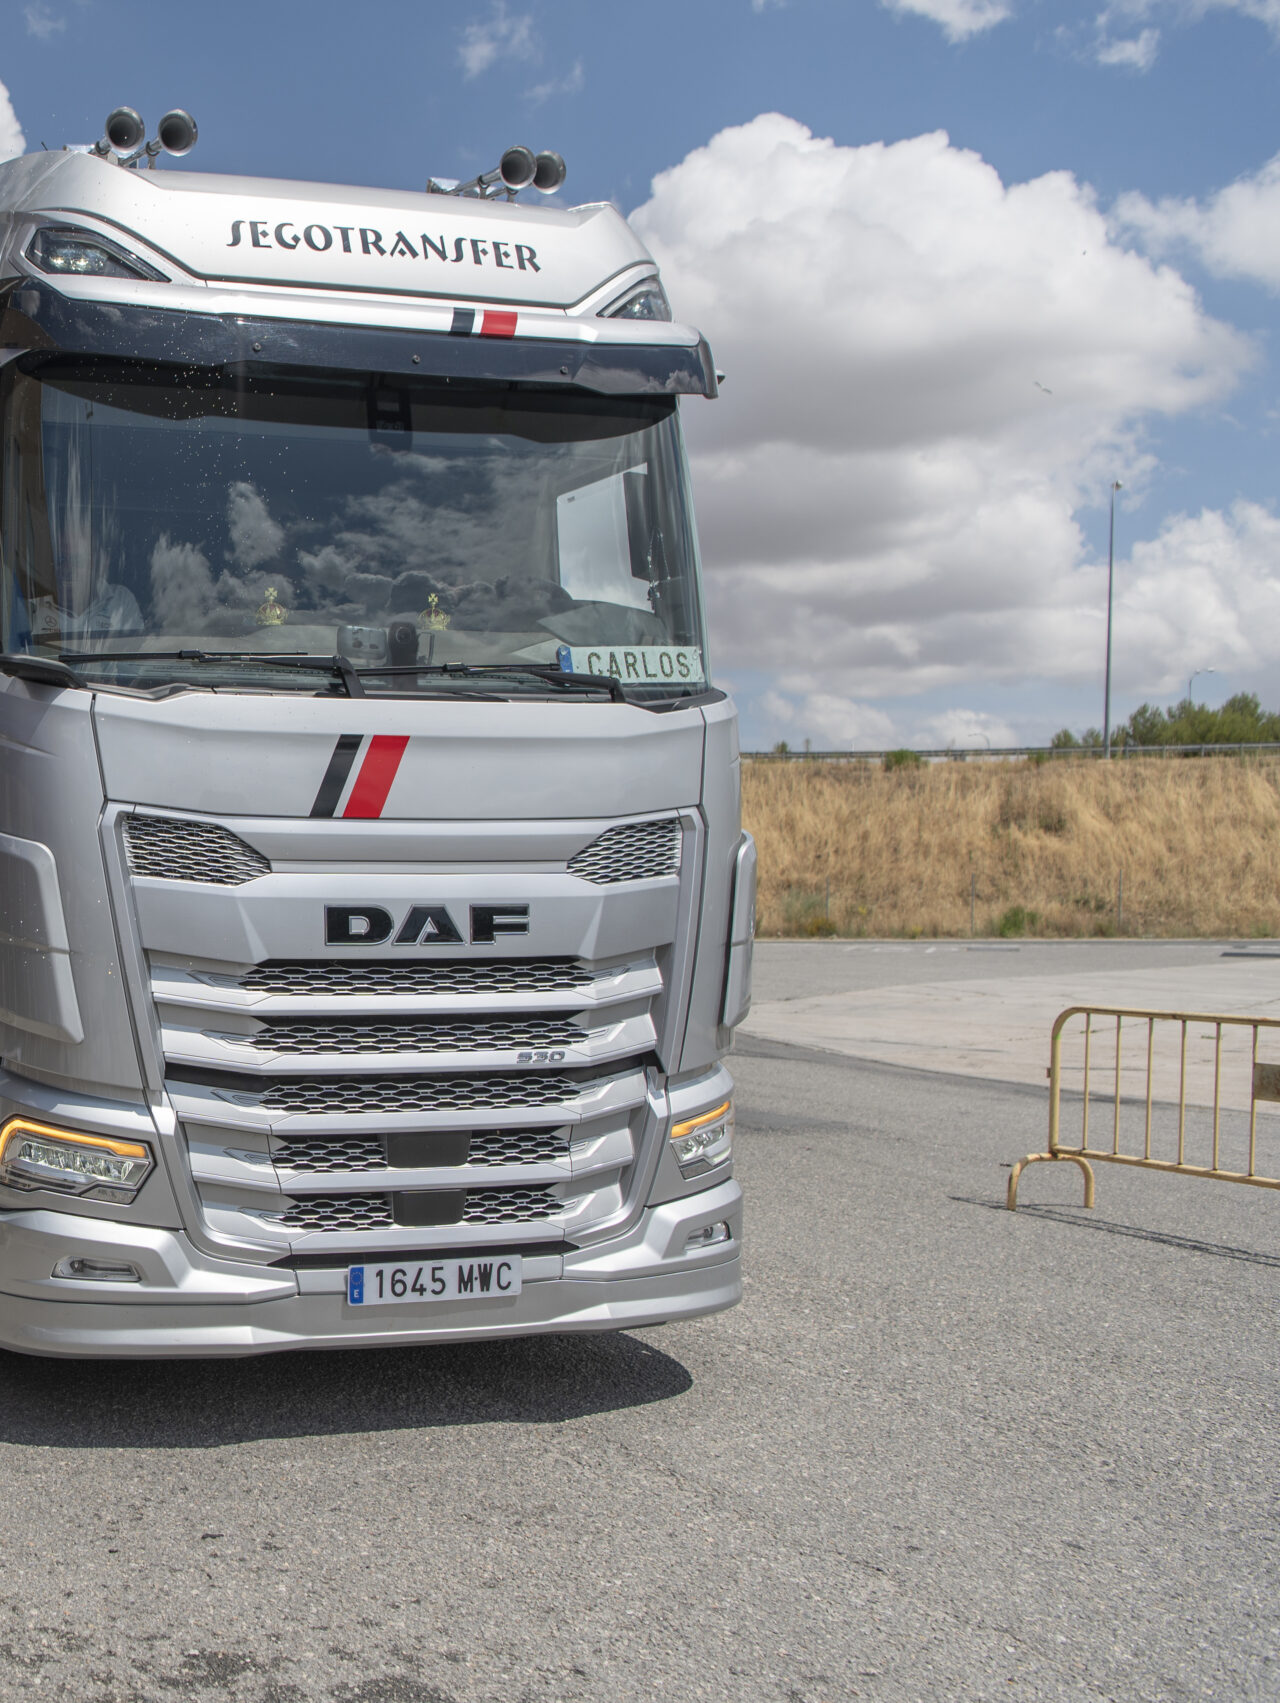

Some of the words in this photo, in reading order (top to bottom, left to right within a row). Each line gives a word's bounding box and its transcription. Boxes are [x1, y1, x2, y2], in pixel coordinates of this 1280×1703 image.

[226, 220, 541, 273] SEGOTRANSFER
[587, 651, 690, 678] CARLOS
[324, 904, 529, 946] DAF
[376, 1267, 447, 1299] 1645
[457, 1262, 512, 1294] MWC
